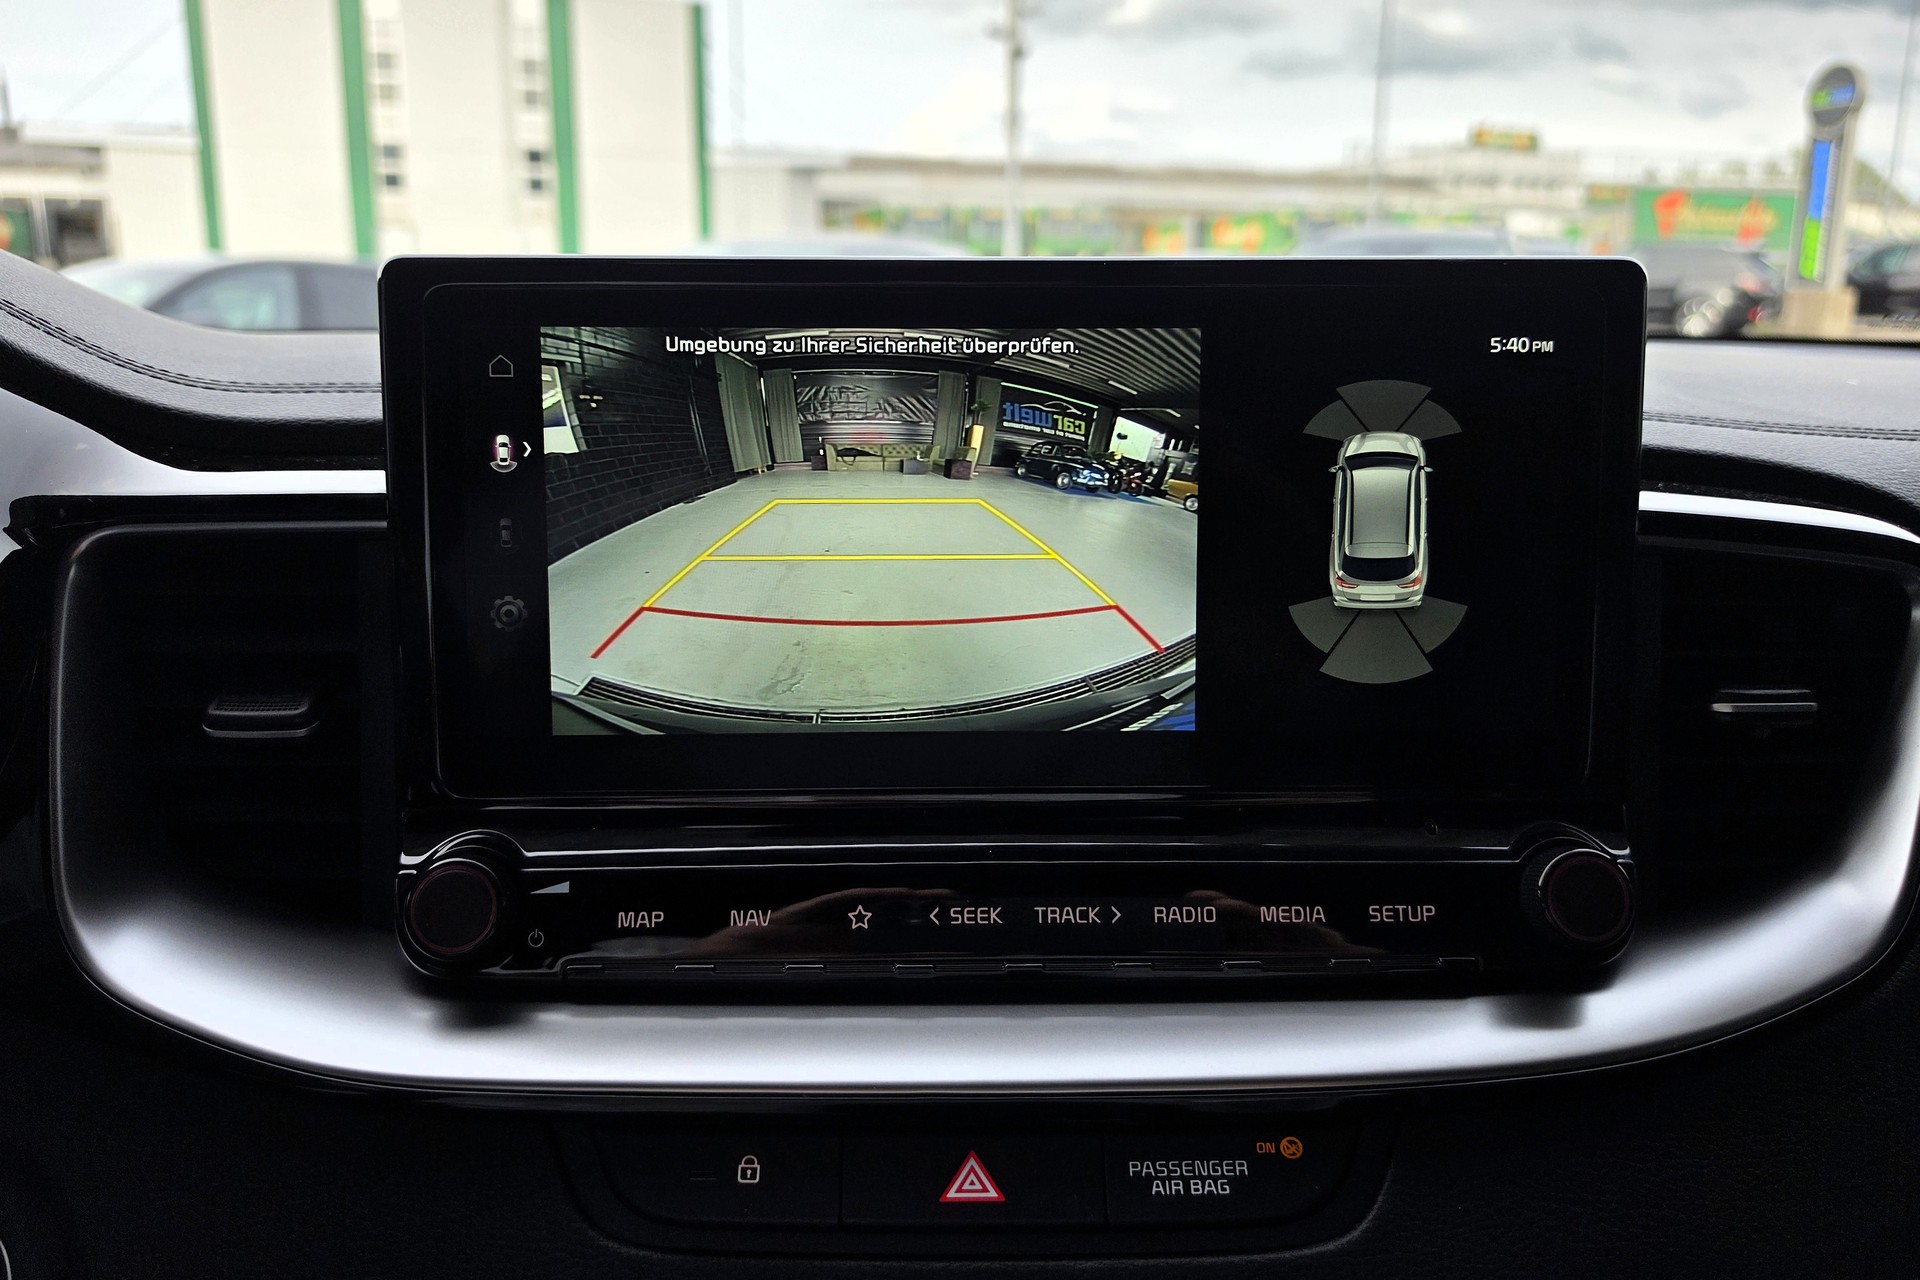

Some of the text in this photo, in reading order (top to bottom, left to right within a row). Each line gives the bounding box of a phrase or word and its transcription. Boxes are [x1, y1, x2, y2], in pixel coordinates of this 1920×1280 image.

[666, 336, 1080, 356] Umgebung zu Ihrer Sicherheit überprüfen.
[1490, 337, 1554, 353] 5:40 PM
[617, 911, 665, 929] MAP
[730, 910, 771, 927] NAV
[950, 906, 1101, 924] SEEK TRACK
[1154, 906, 1217, 923] RADIO
[1260, 906, 1326, 923] MEDIA
[1369, 905, 1436, 922] SETUP
[1256, 1142, 1276, 1153] ON
[1129, 1160, 1249, 1176] PASSENGER
[1152, 1180, 1230, 1195] AIR BAG
